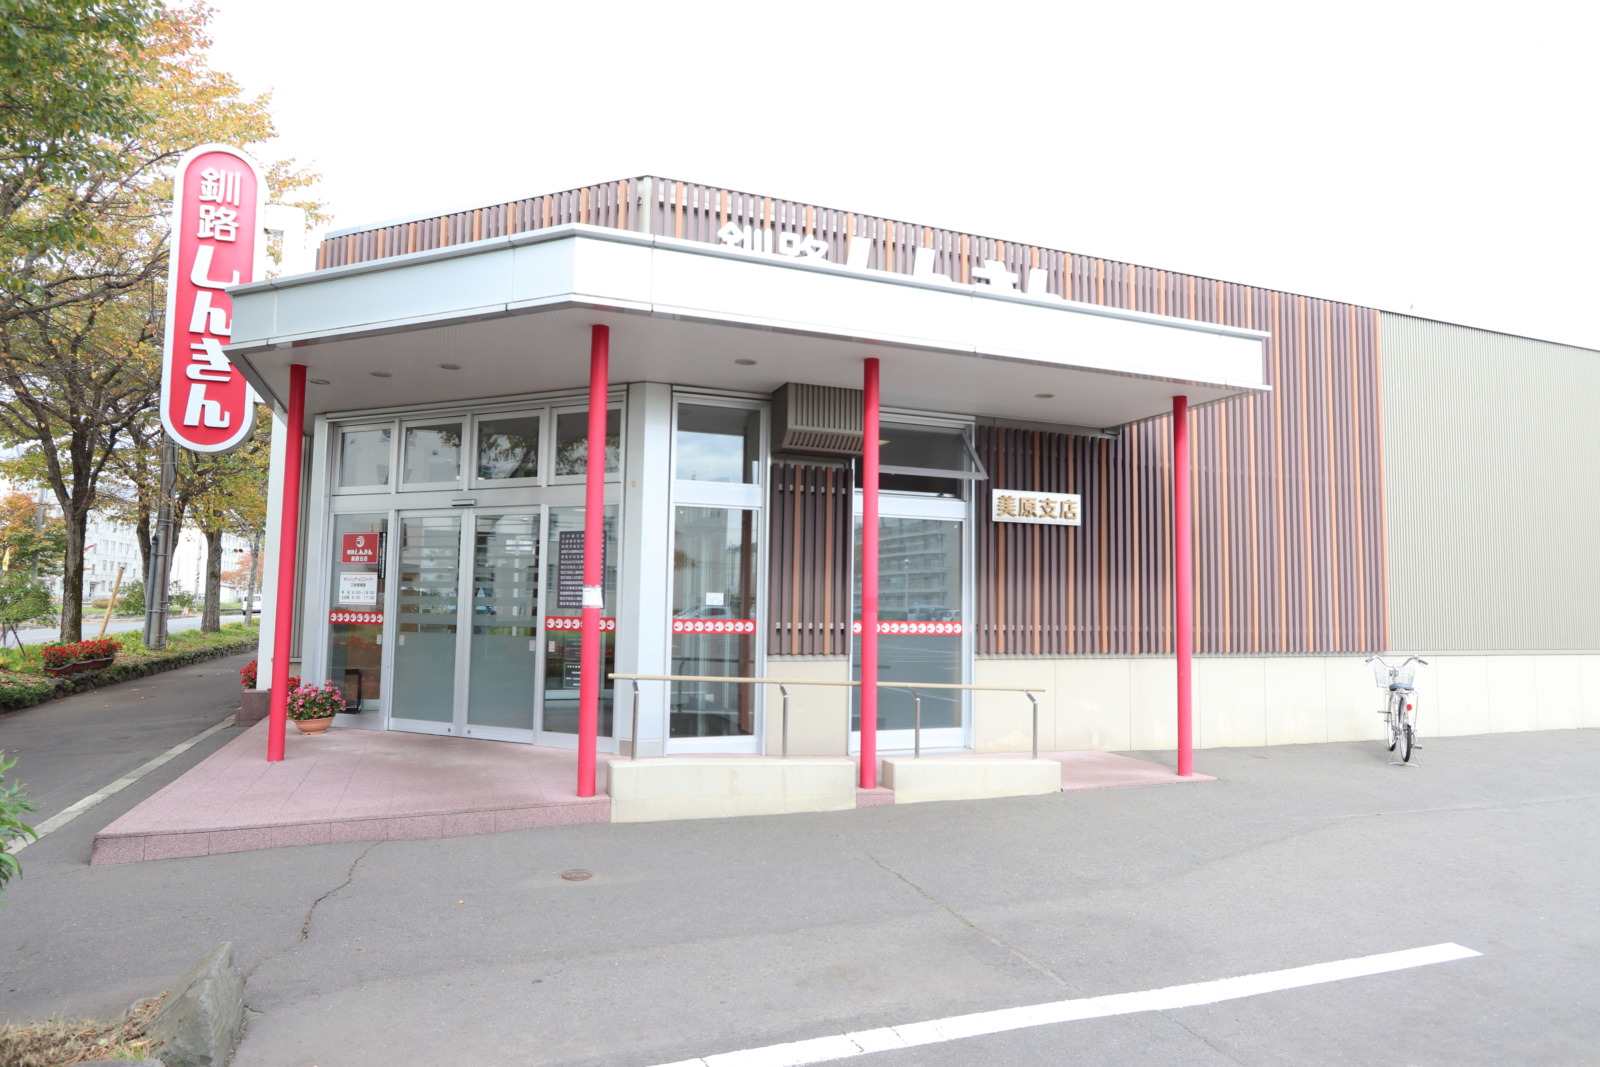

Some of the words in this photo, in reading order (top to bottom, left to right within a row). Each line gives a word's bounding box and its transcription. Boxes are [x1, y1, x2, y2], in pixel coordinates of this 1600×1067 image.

[183, 167, 240, 429] 釧路しんきん
[997, 495, 1078, 519] 美原支店
